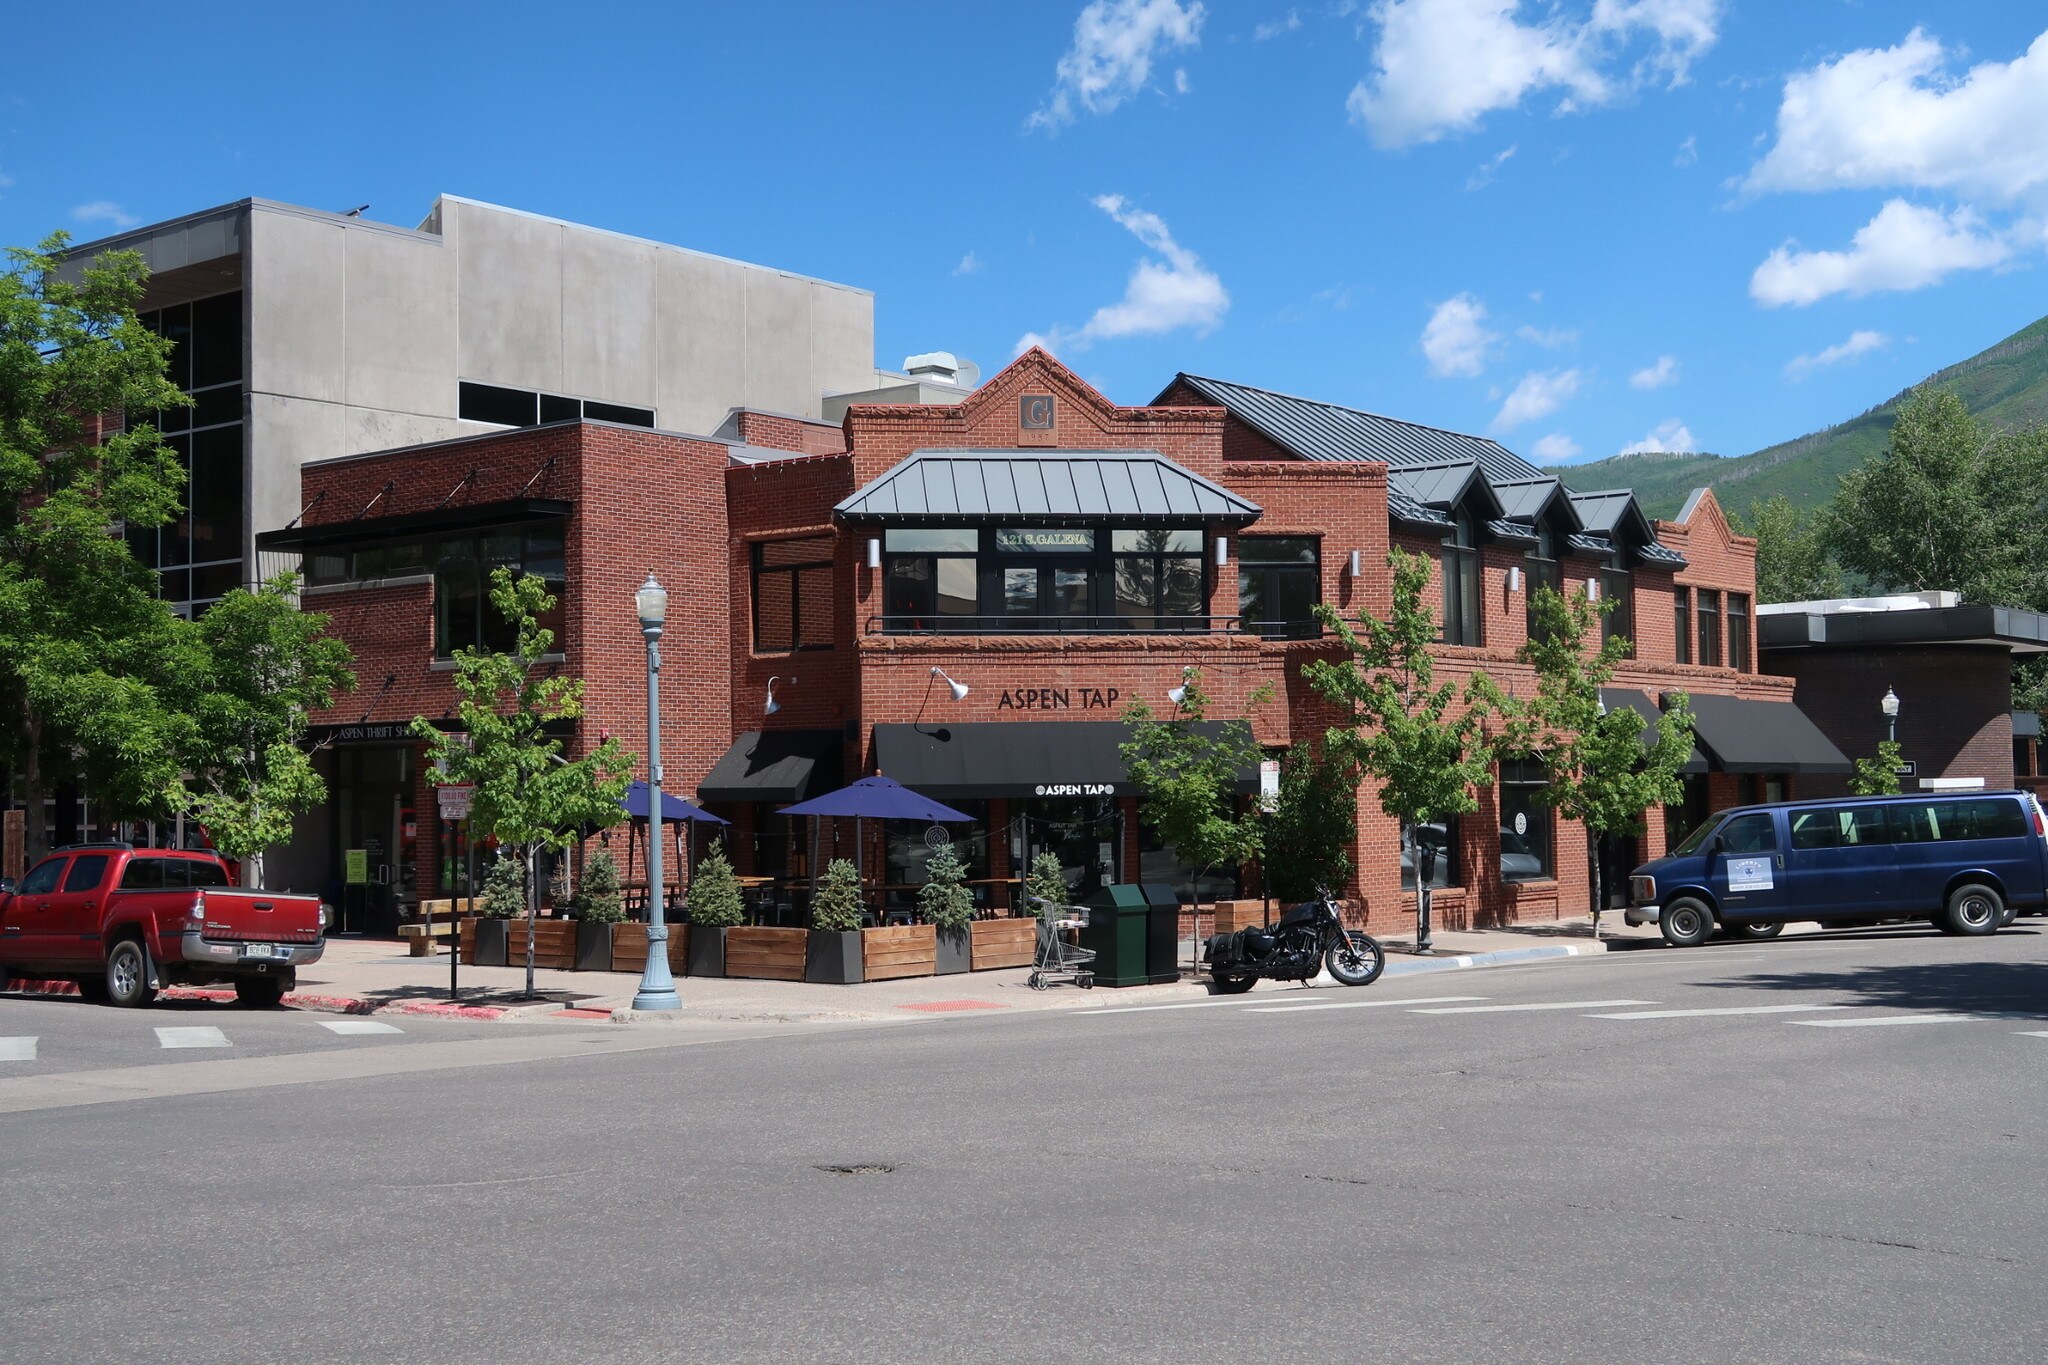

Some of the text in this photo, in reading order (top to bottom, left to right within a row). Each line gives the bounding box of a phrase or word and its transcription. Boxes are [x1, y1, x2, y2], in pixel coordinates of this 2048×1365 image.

[1024, 399, 1051, 426] G
[1025, 433, 1050, 442] 1987
[1002, 534, 1023, 545] 121
[998, 687, 1120, 710] ASPEN TAP
[339, 728, 364, 739] ASPEN
[366, 726, 393, 739] THRIFT
[1045, 784, 1105, 796] ASPEN TAP
[1735, 860, 1762, 870] LIBERTY
